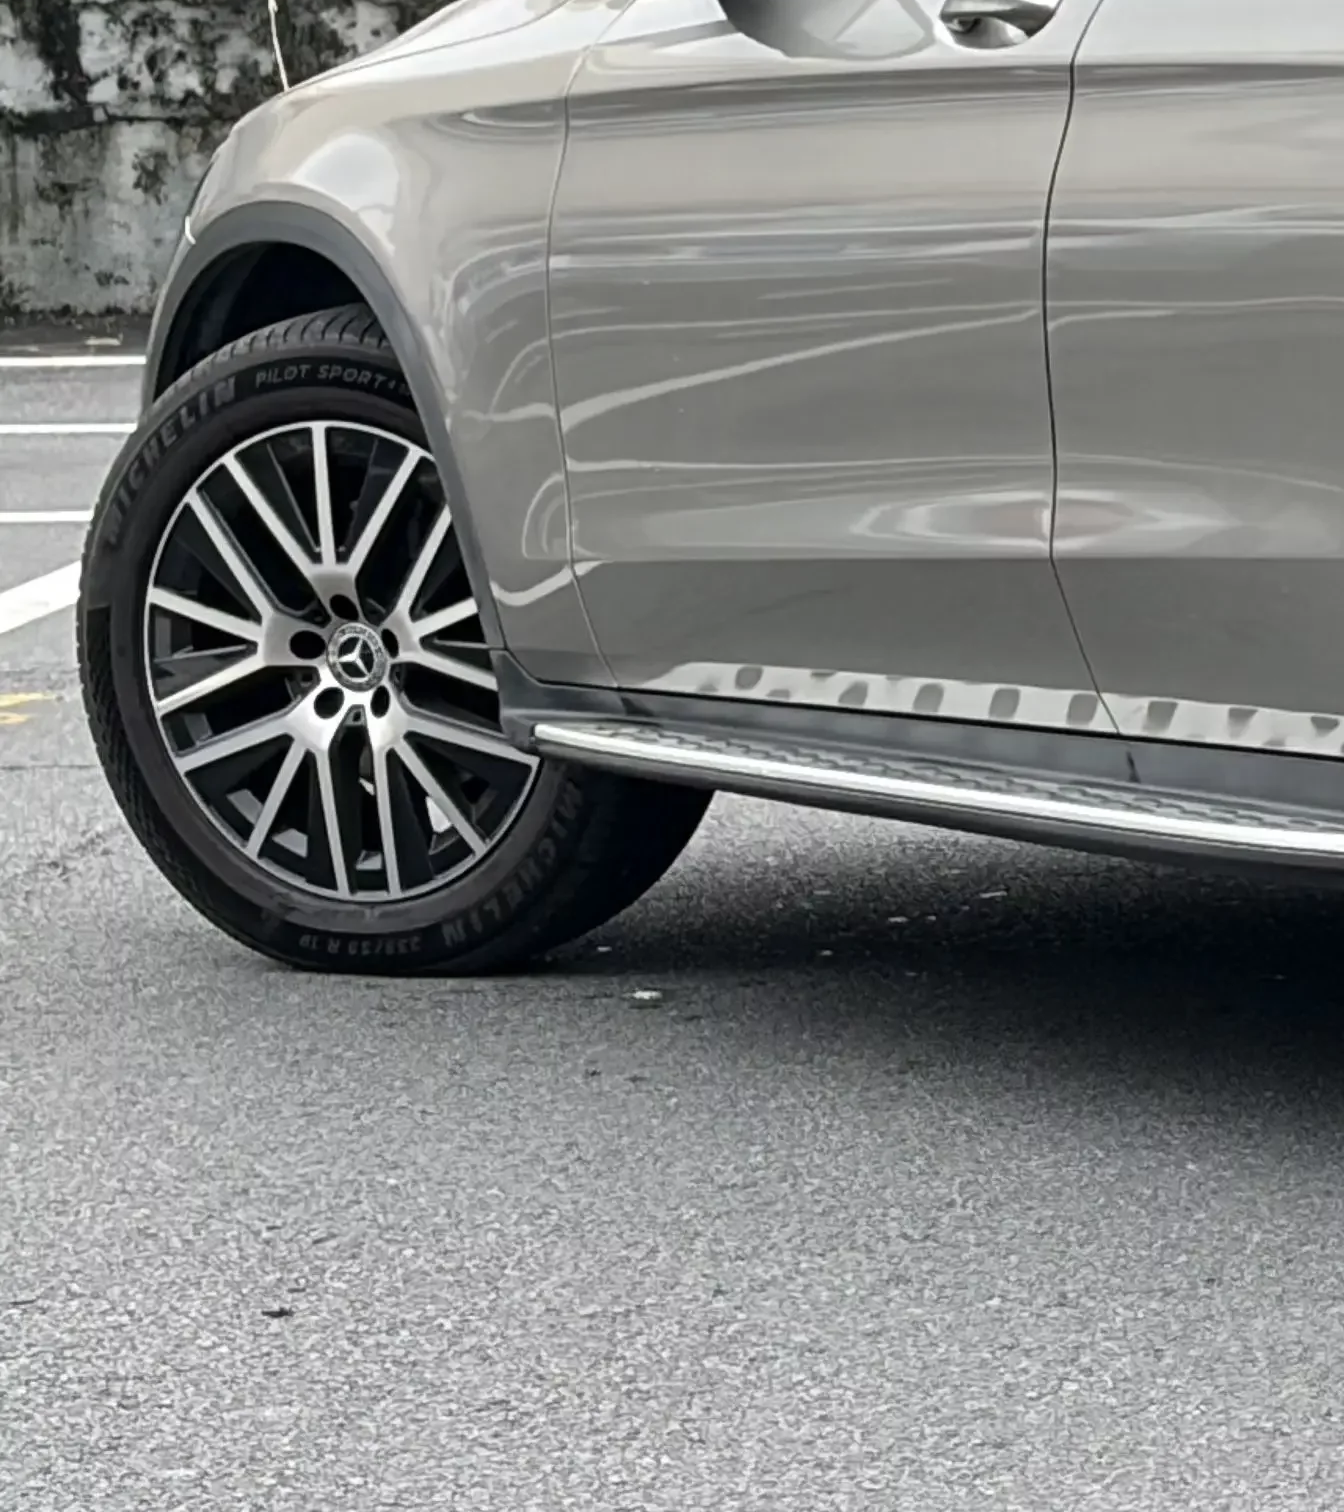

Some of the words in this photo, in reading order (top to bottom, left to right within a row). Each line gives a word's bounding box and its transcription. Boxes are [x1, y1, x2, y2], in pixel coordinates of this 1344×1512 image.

[104, 375, 236, 545] MICHELIN
[255, 363, 311, 387] PILOT
[317, 363, 389, 389] SPORT
